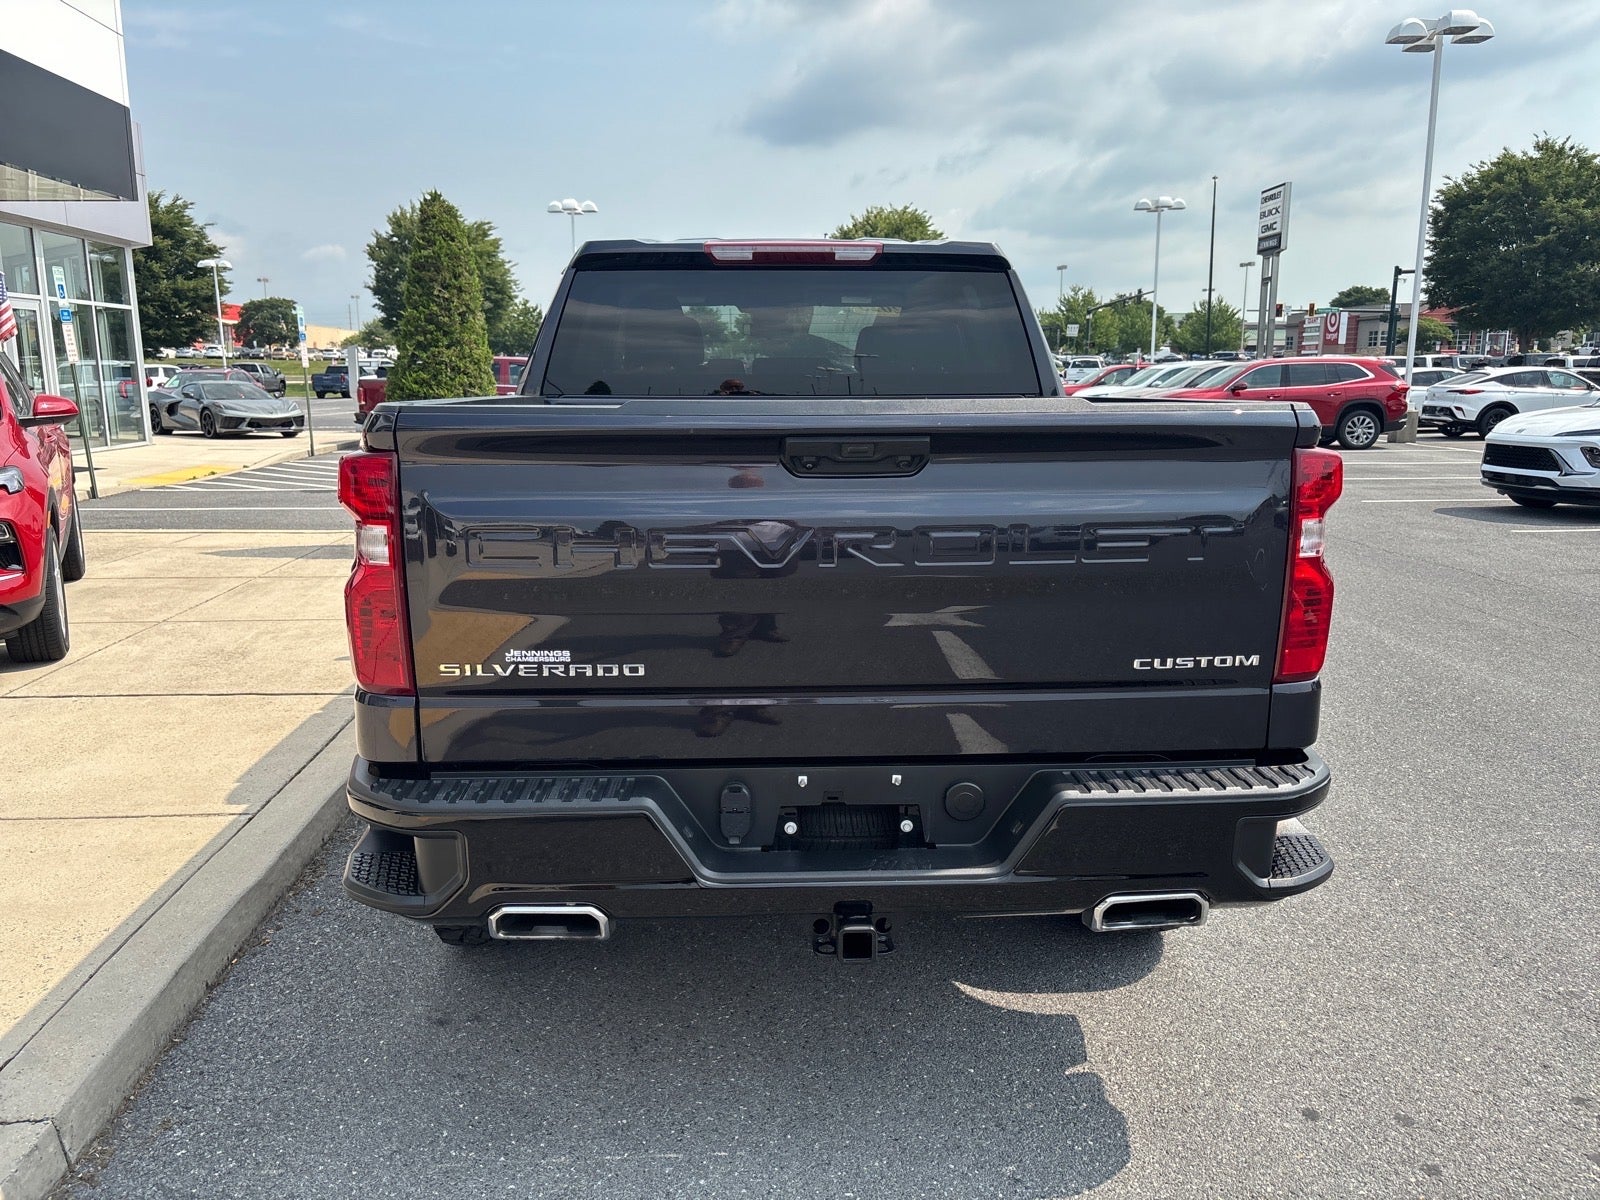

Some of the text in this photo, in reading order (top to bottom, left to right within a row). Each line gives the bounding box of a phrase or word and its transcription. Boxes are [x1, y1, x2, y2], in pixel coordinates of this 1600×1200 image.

[1260, 206, 1280, 219] BUICK
[1261, 221, 1277, 233] GMC
[464, 522, 1236, 569] CHEVROLET
[1132, 654, 1261, 671] CUSTOM
[438, 663, 646, 678] SILVERADO
